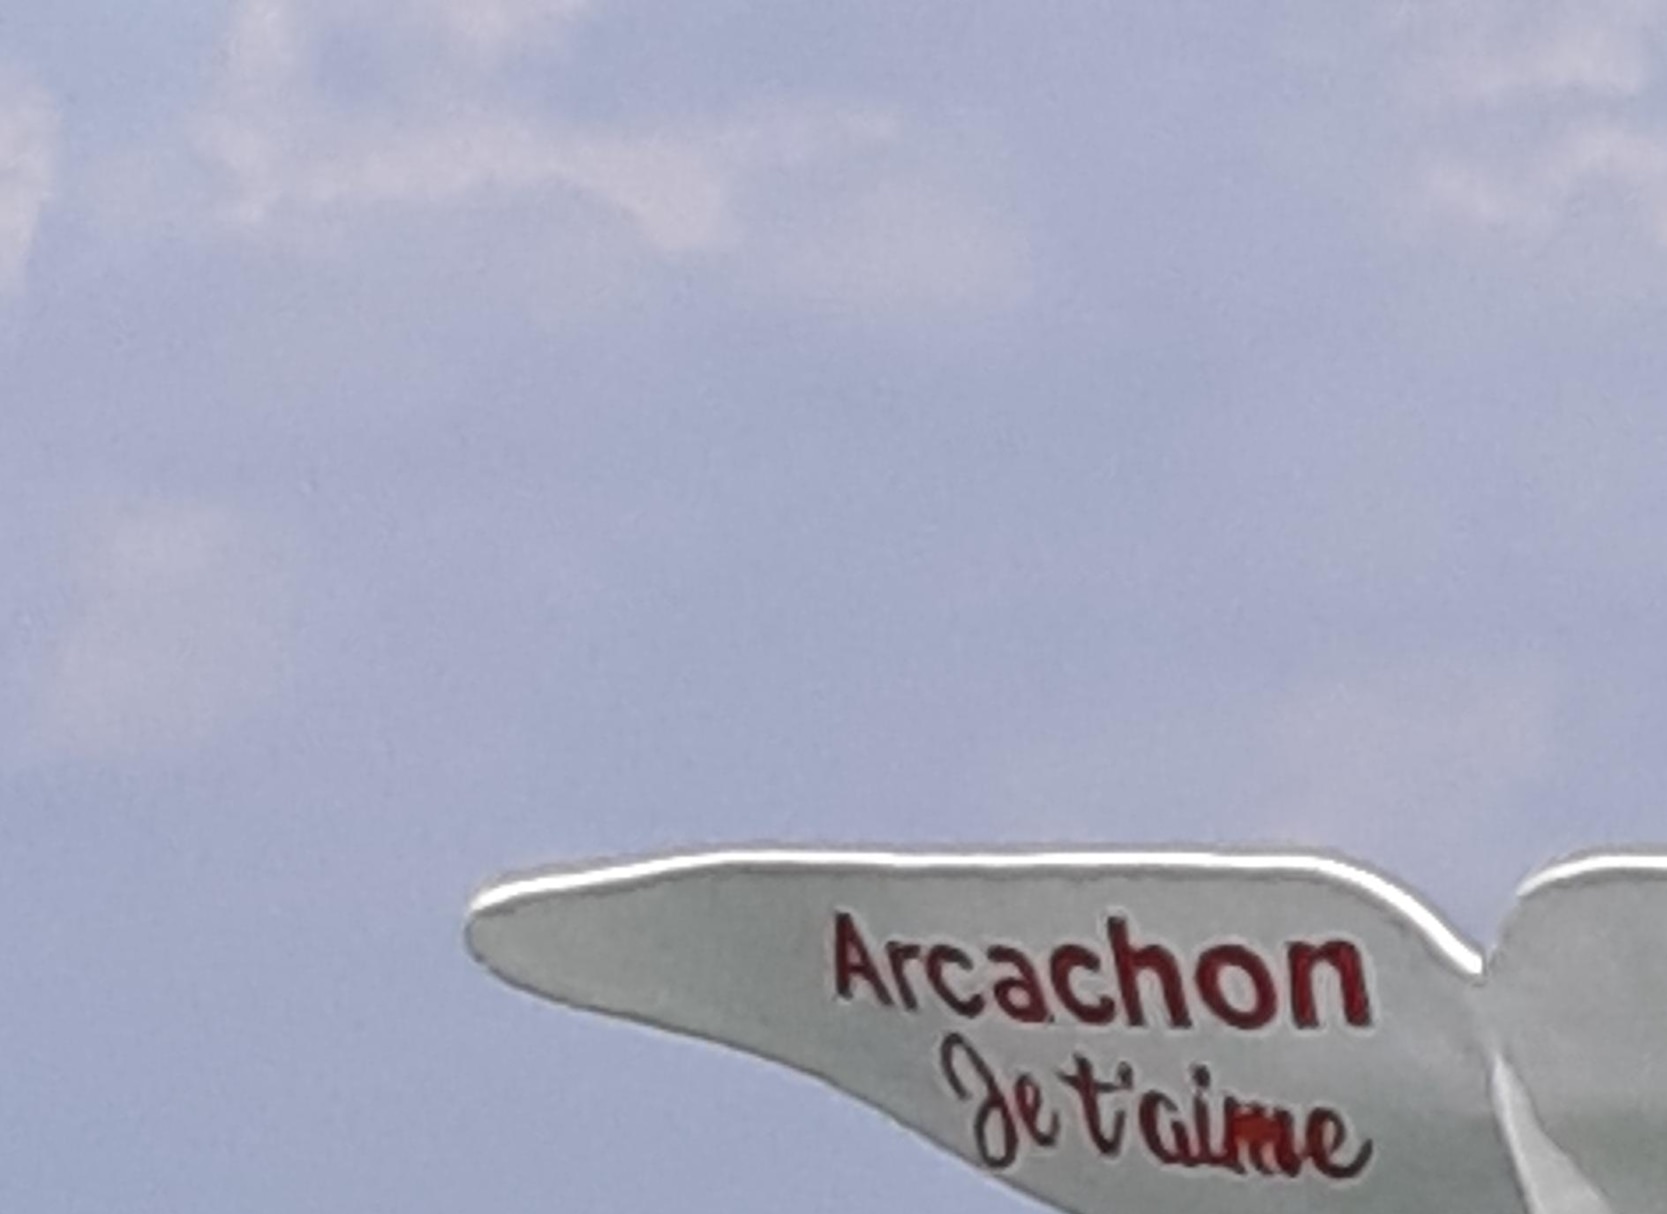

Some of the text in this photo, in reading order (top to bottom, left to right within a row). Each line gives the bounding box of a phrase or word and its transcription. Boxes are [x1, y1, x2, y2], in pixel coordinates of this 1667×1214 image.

[834, 911, 1373, 1030] Arcachon
[940, 1032, 1373, 1179] Je t'aime
